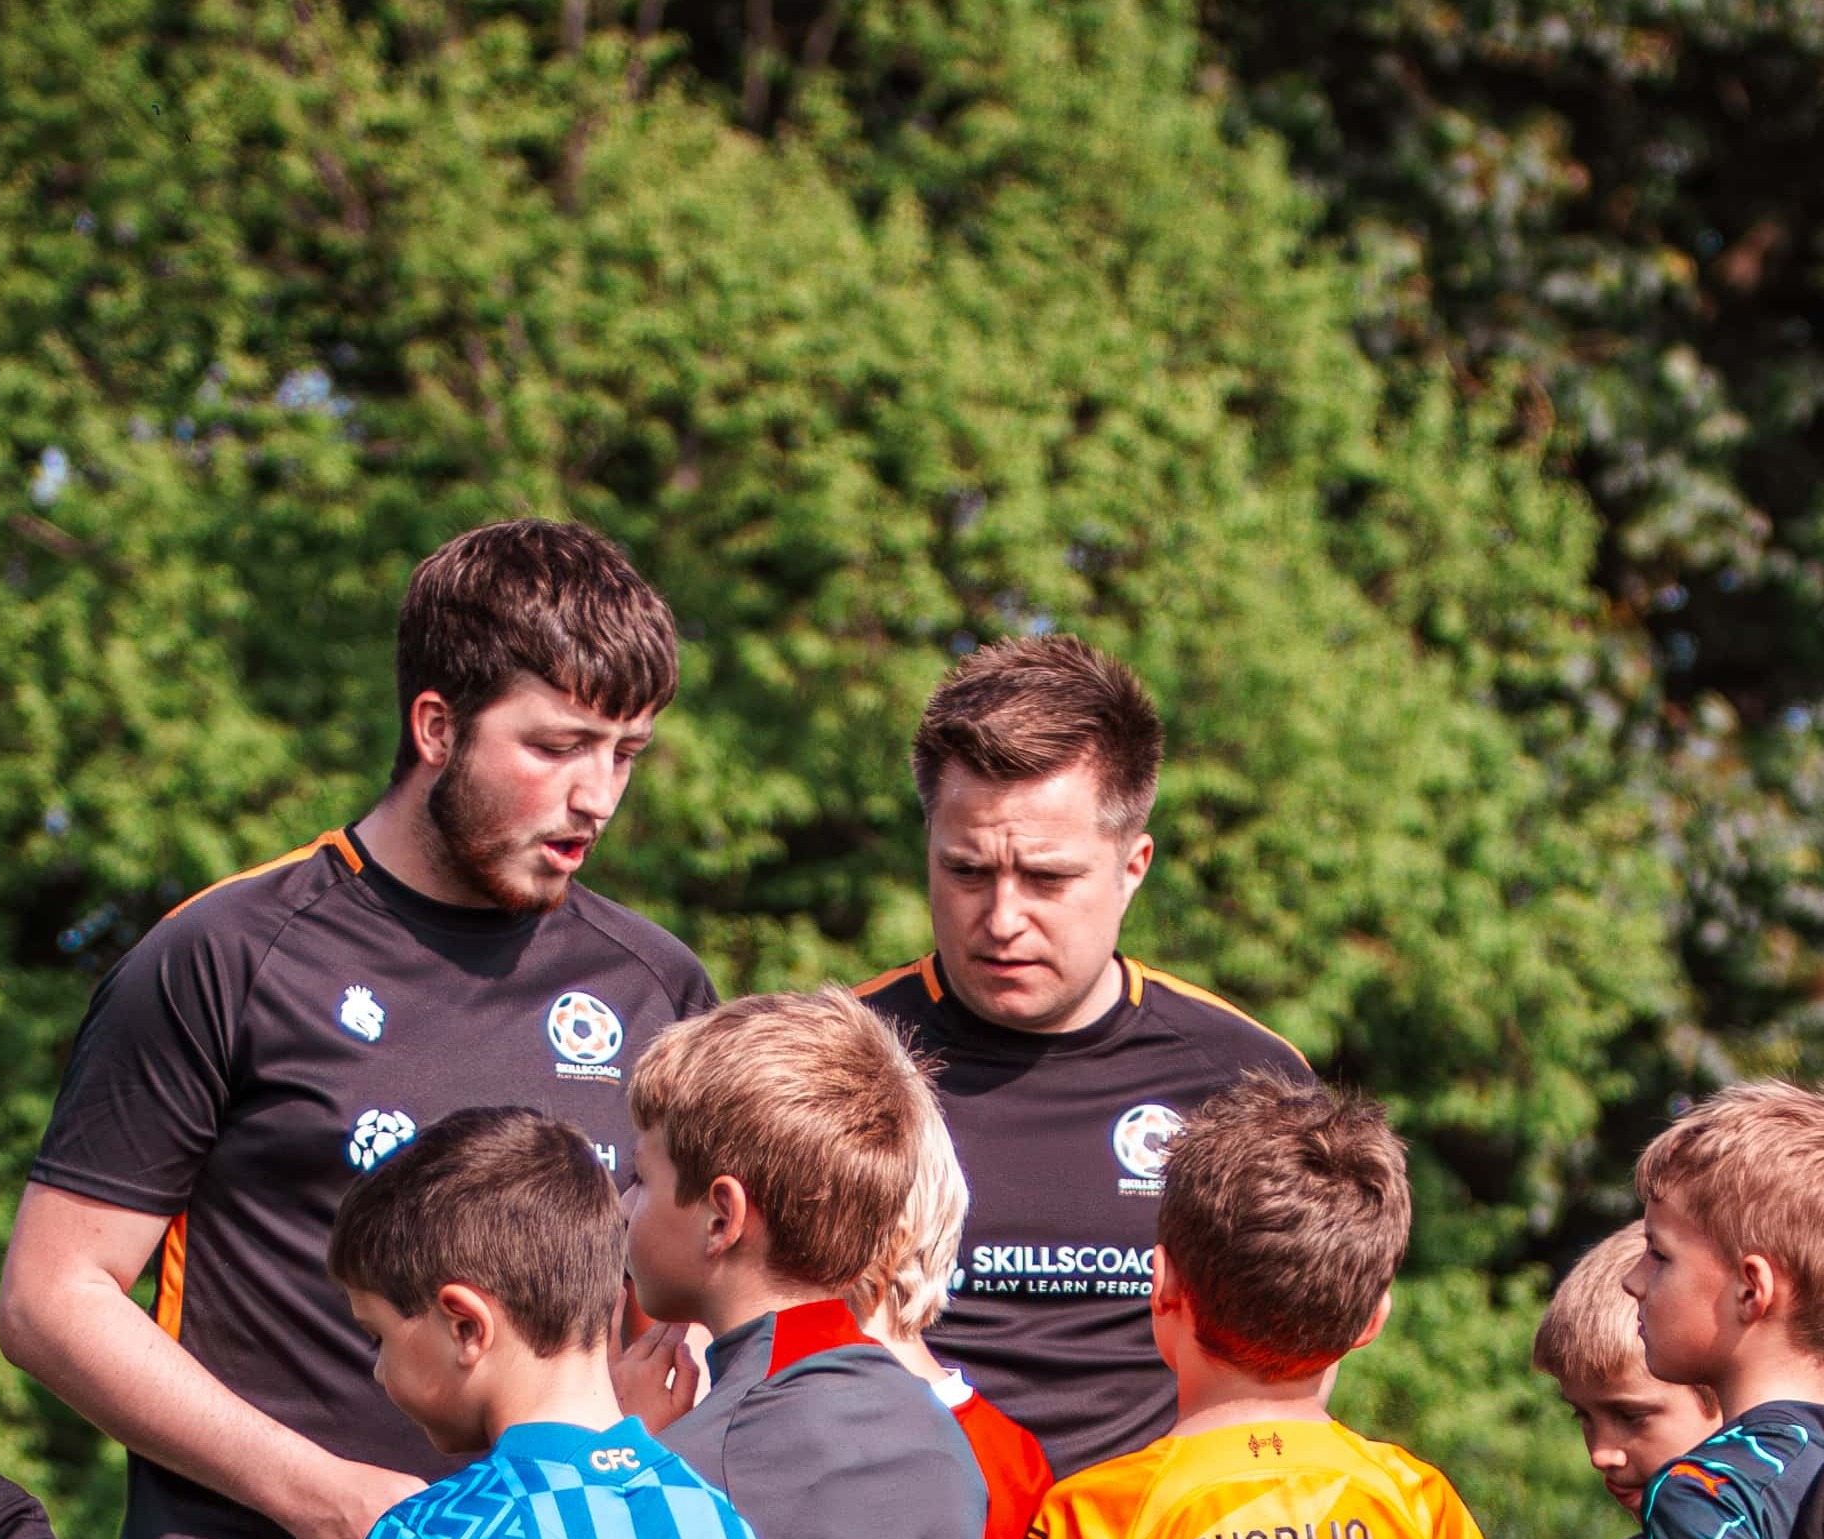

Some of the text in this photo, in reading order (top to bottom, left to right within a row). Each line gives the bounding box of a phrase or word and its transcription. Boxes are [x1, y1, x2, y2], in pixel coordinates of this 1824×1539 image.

[973, 1280, 1020, 1292] PLAY
[1028, 1280, 1088, 1292] LEARN
[591, 1447, 641, 1471] CFC
